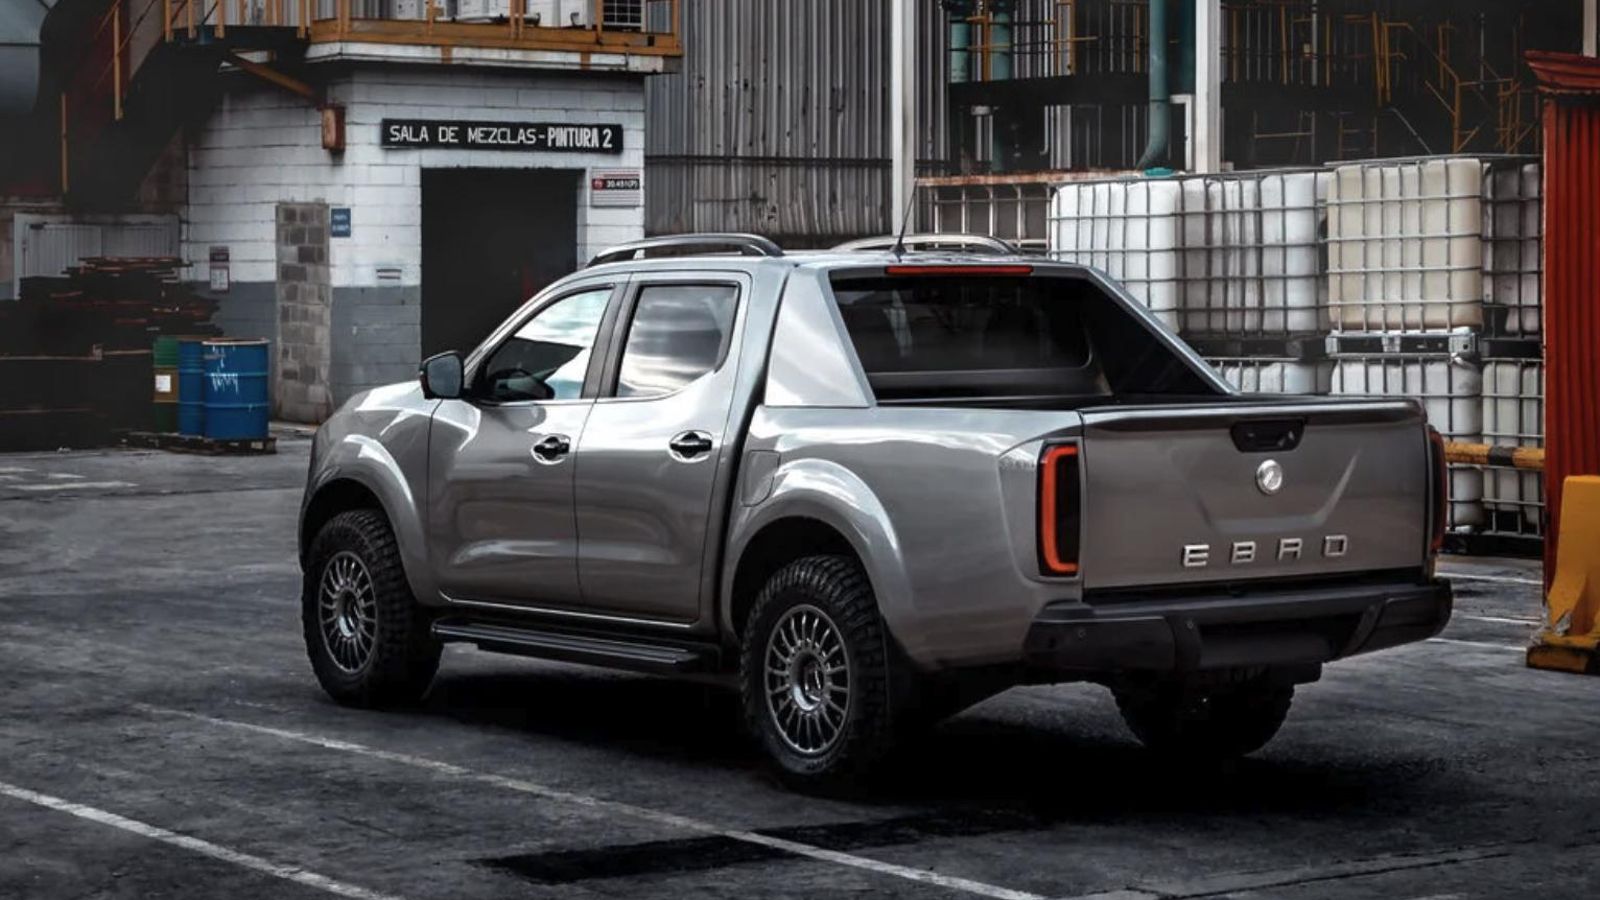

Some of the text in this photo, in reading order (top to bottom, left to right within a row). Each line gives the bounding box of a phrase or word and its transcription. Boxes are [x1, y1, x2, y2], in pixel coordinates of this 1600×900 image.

[389, 125, 429, 143] SALA
[438, 126, 459, 143] DE
[602, 128, 613, 148] 2
[1183, 535, 1348, 567] EBRO
